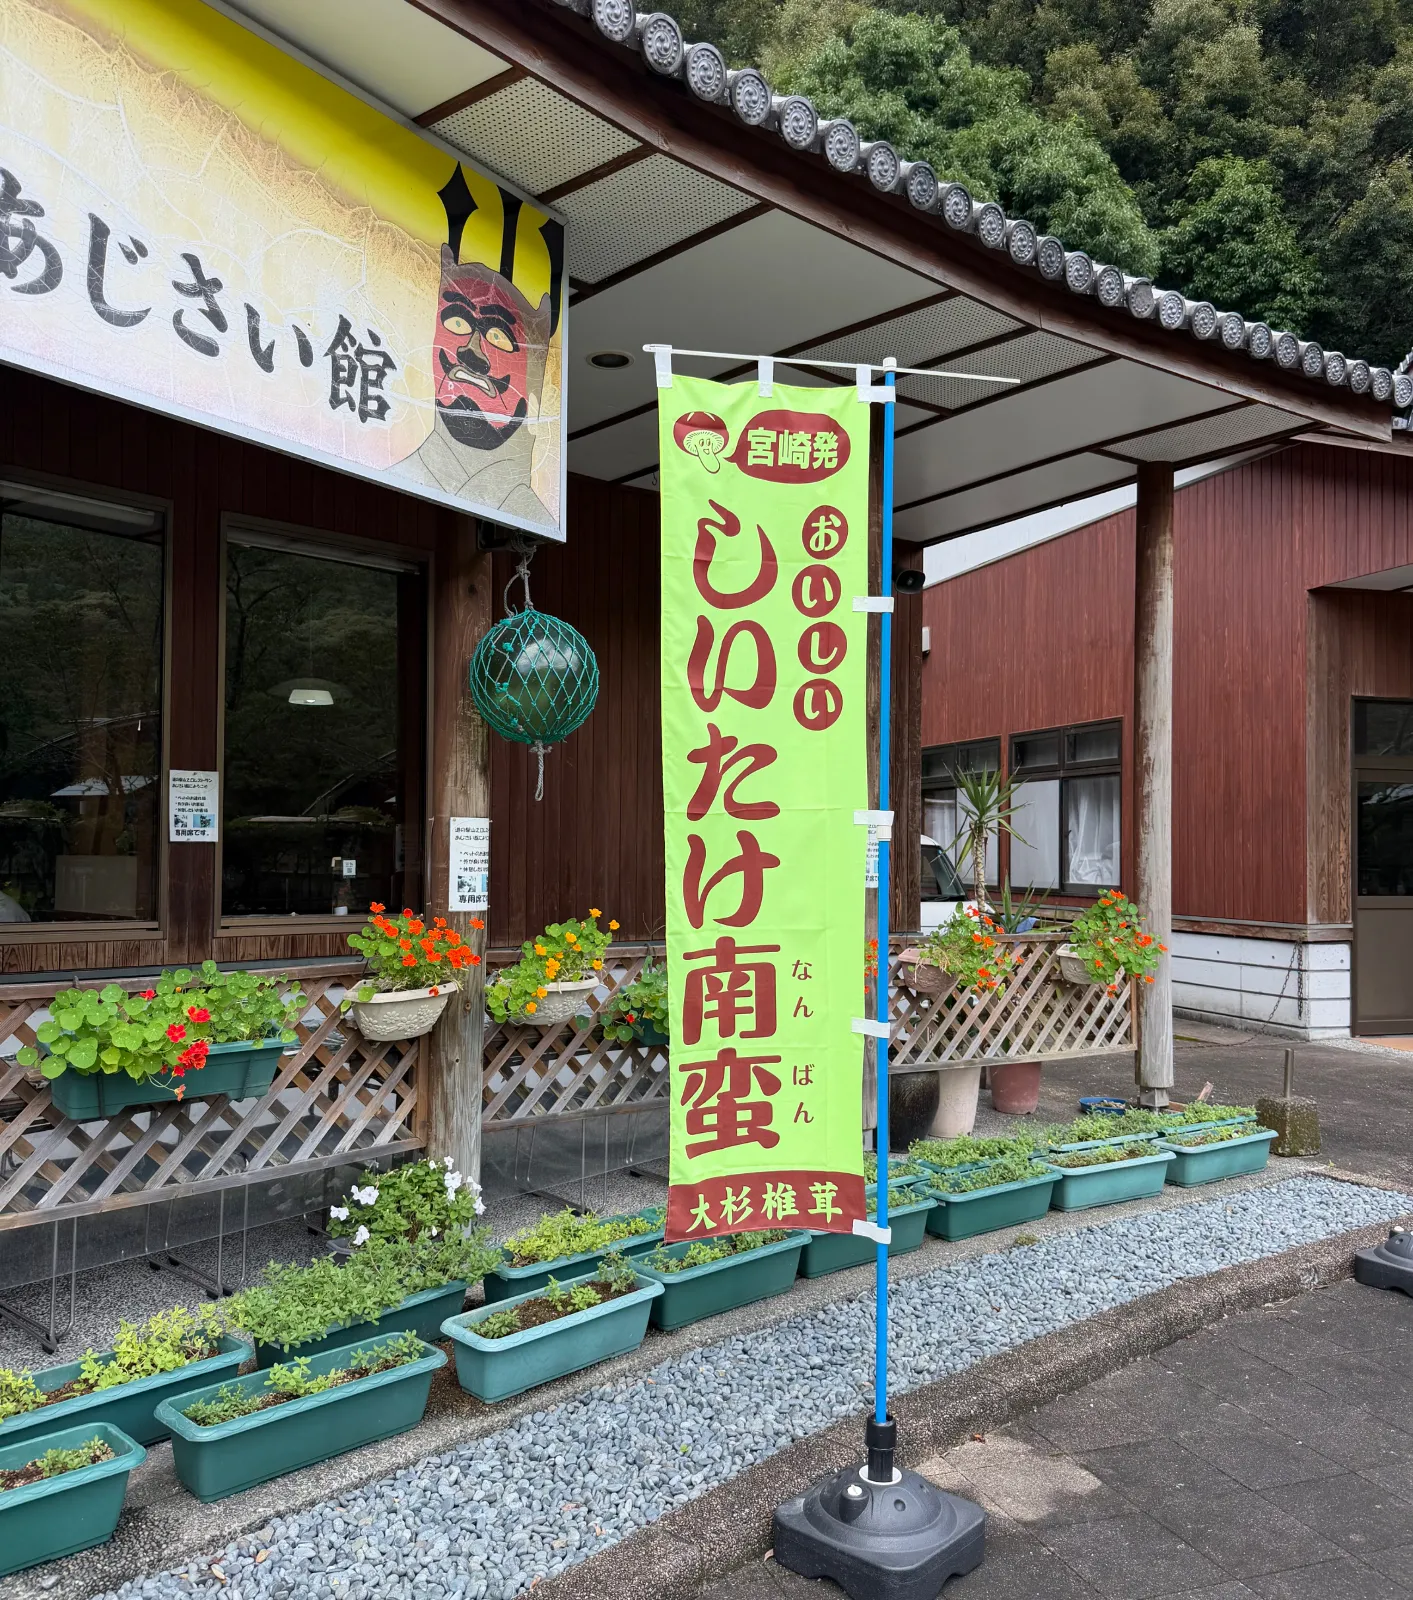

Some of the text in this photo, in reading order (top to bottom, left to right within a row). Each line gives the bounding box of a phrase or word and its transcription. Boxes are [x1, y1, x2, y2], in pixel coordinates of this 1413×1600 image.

[747, 426, 839, 470] 宮崎発
[801, 512, 843, 722] おいしい
[679, 498, 782, 1160] しいたけ南蛮
[686, 1181, 843, 1234] 大杉椎茸
